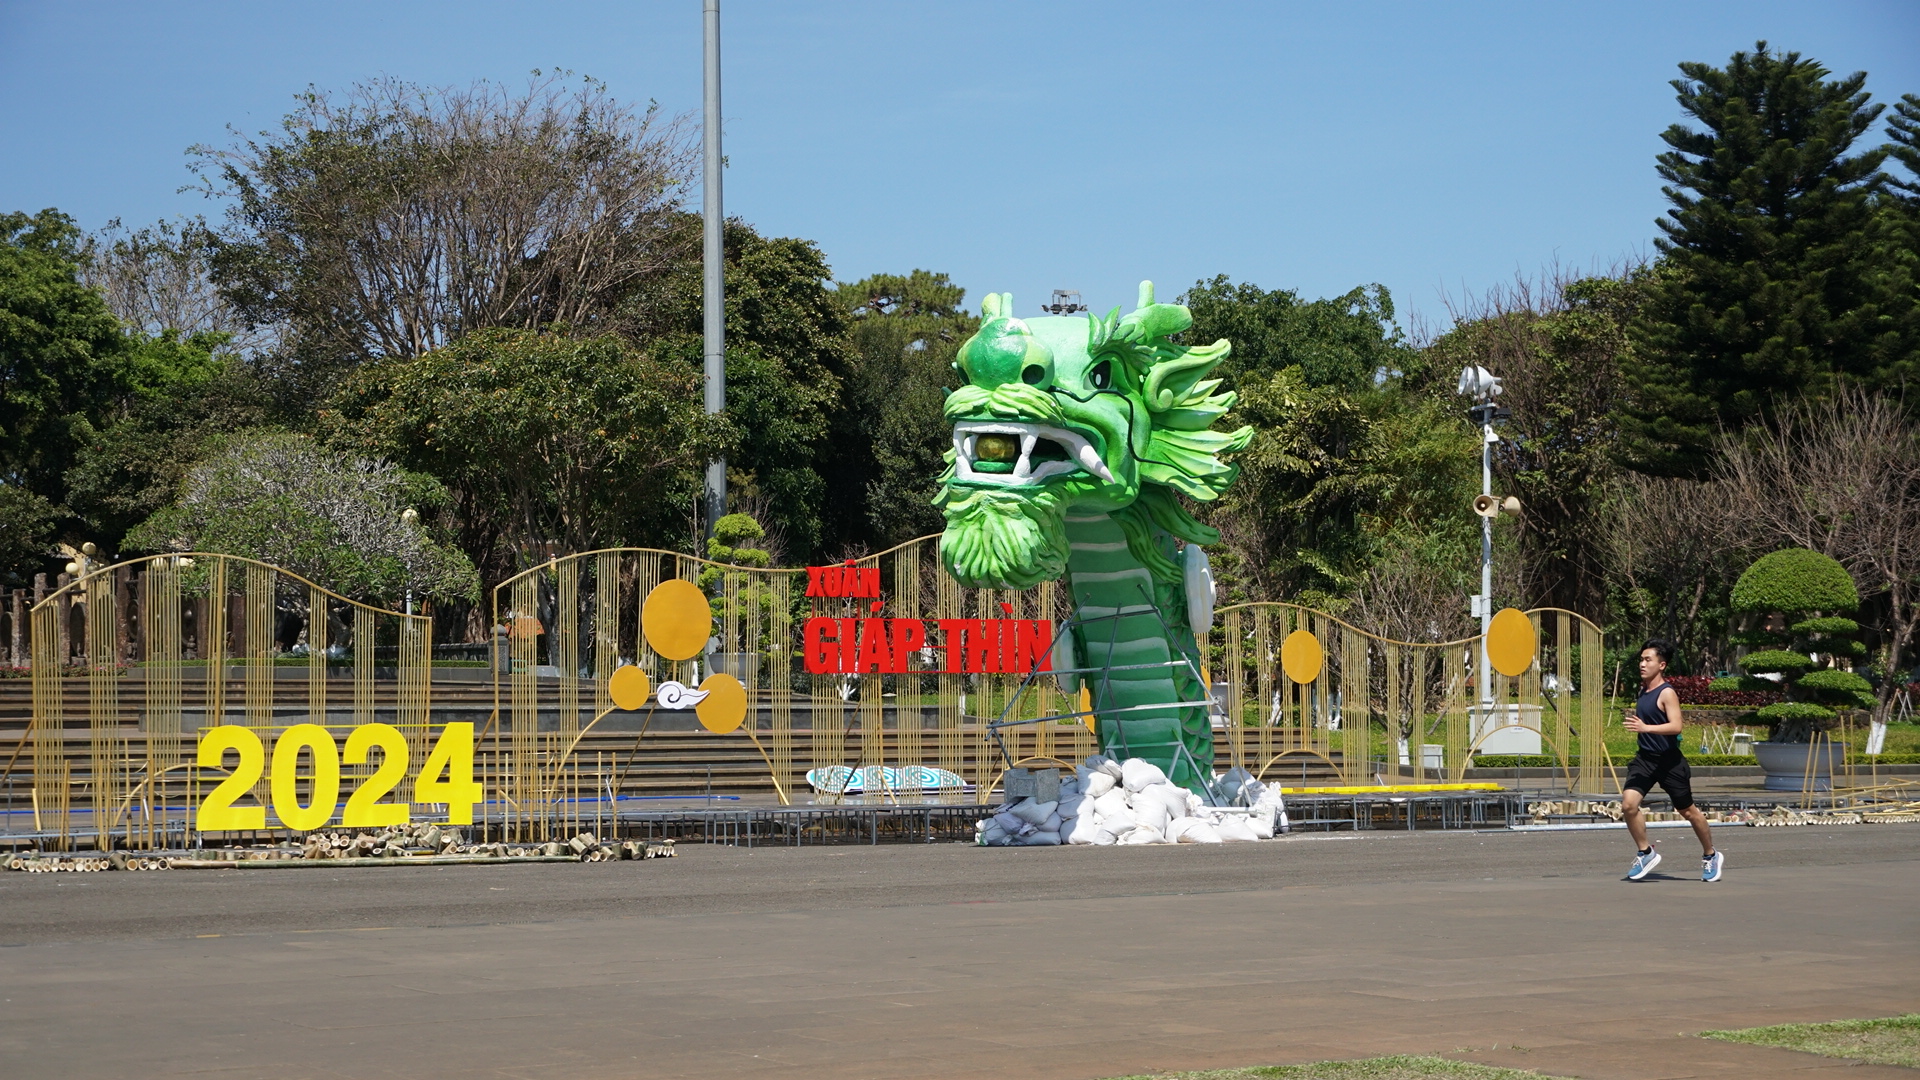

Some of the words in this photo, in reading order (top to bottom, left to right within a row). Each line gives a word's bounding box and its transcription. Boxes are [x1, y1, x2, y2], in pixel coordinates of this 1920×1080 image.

[804, 559, 881, 598] XUÂN
[804, 601, 925, 674] GIÁP
[940, 602, 1053, 673] THÌN
[196, 721, 484, 831] 2024
